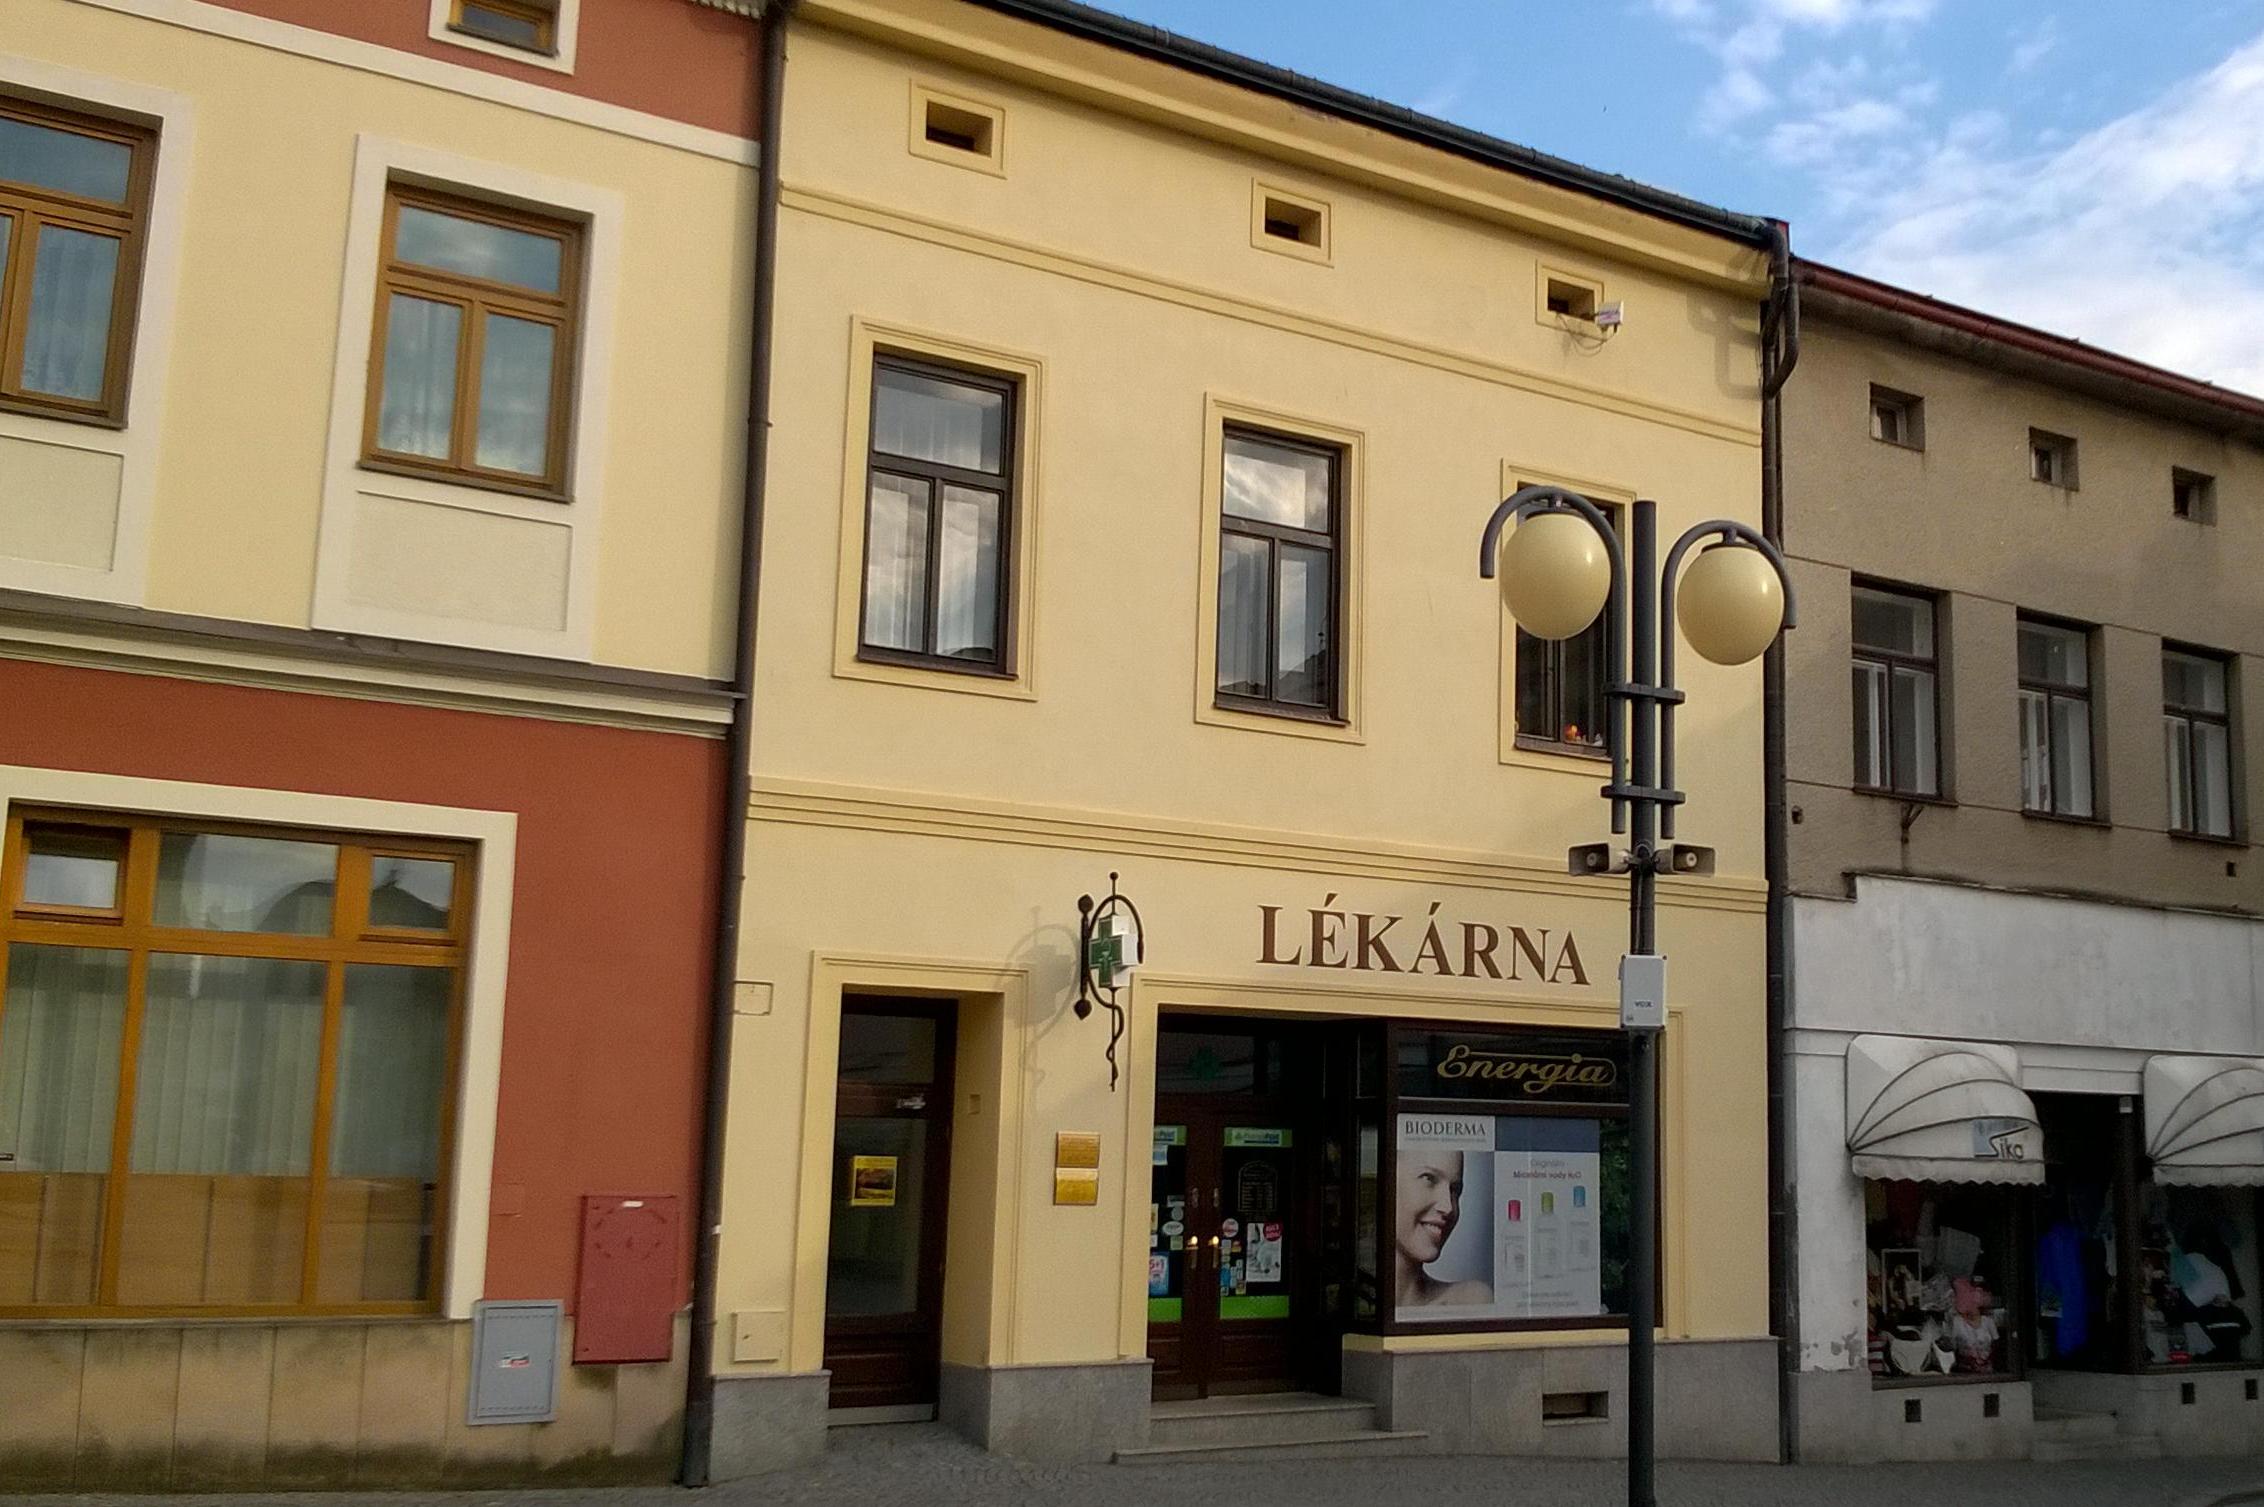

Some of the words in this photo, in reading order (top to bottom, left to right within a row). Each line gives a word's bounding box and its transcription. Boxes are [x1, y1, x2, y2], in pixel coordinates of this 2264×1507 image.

[1256, 893, 1591, 986] LÉKÁRNA
[1437, 1044, 1616, 1094] Energia
[1405, 1120, 1487, 1137] BIODERMA
